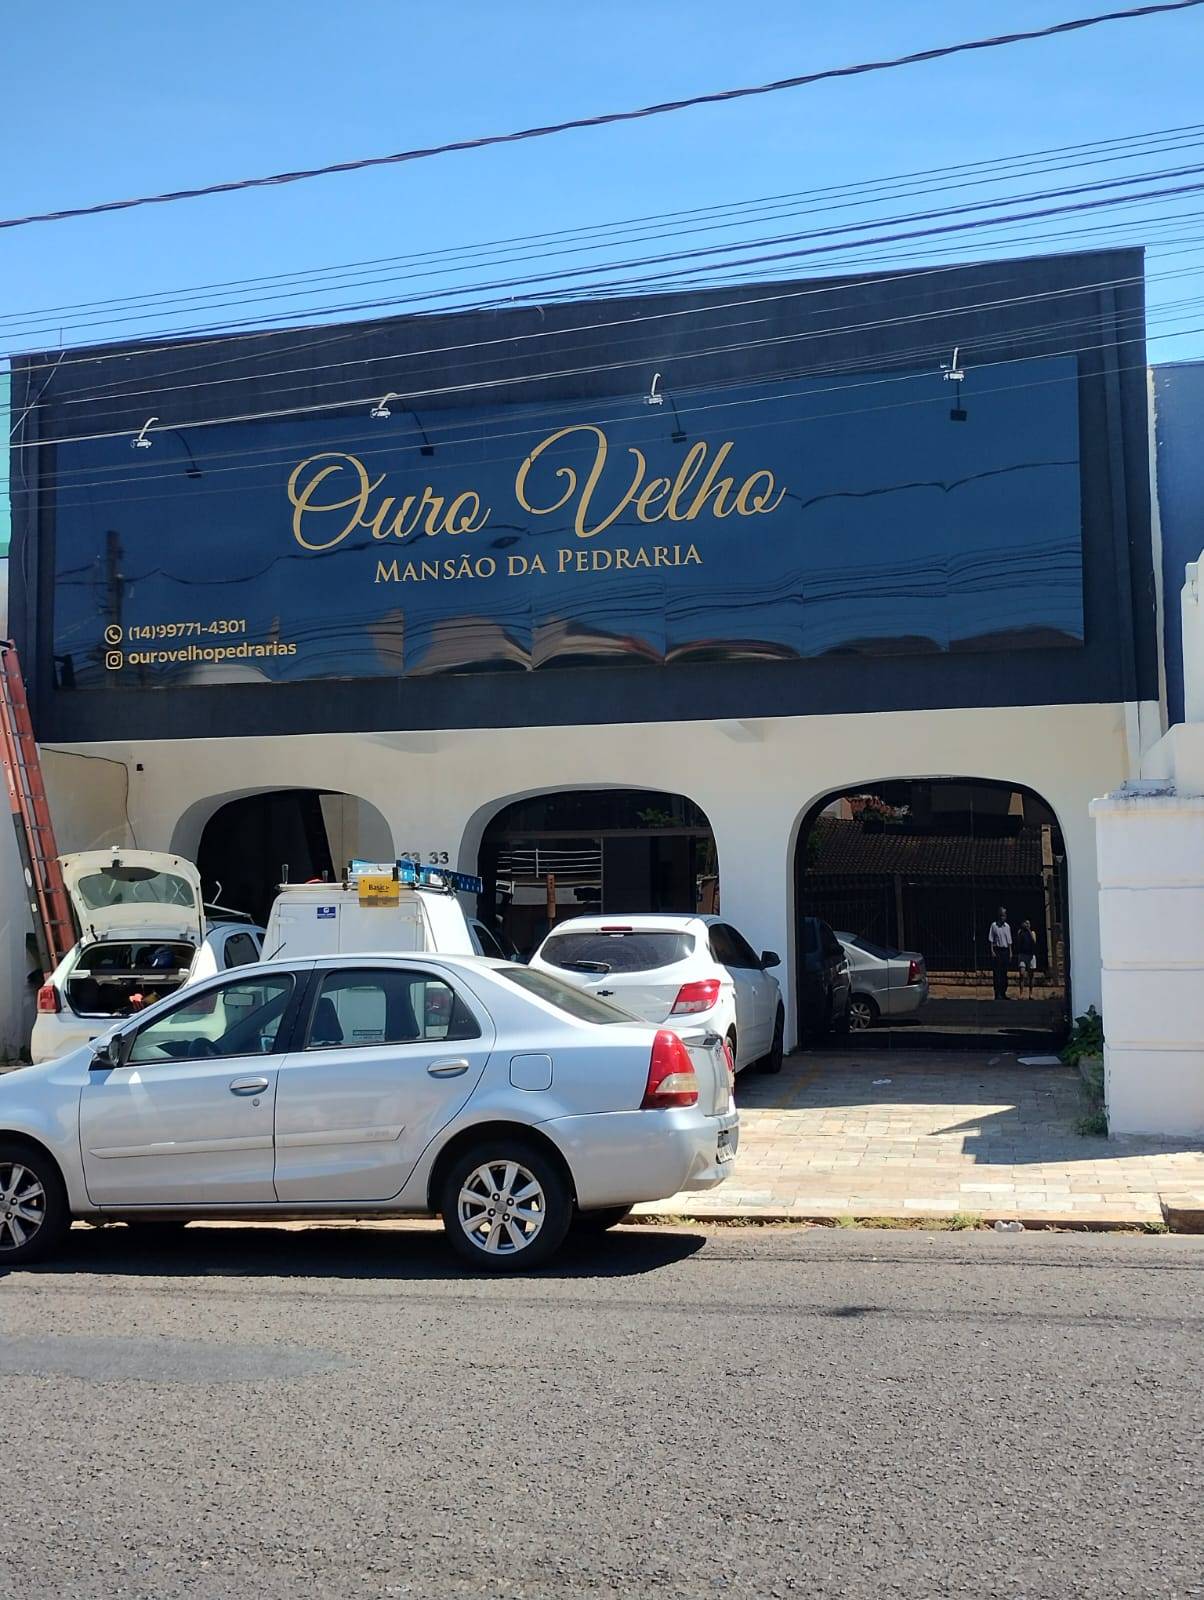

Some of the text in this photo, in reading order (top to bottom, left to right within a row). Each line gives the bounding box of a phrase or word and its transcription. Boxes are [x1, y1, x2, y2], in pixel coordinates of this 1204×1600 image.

[287, 424, 787, 551] Ouro Velho
[374, 543, 703, 583] MANSÃO DA PEDRARIA
[128, 619, 247, 640] (14)99771-4301
[128, 641, 297, 664] ourovelhopedrarias
[429, 851, 449, 865] 33
